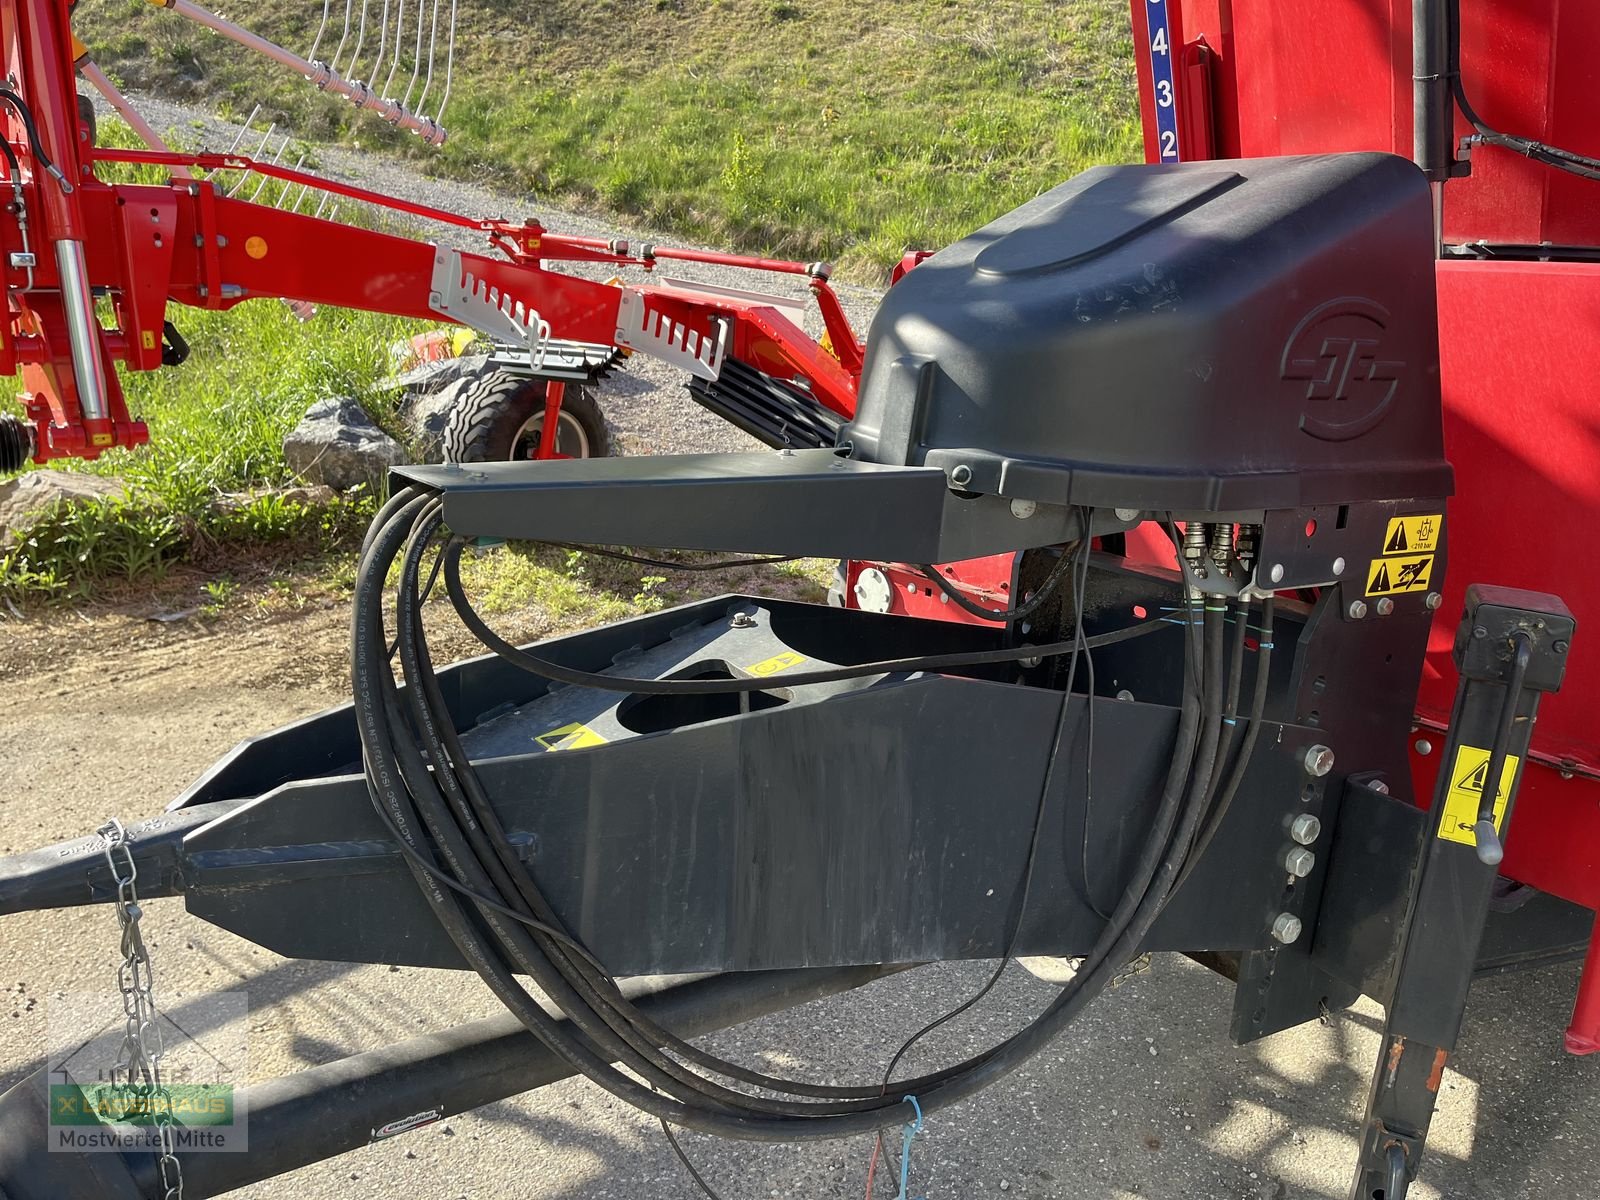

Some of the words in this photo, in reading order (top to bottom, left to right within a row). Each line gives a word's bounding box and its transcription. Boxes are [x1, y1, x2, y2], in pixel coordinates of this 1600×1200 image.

[1152, 27, 1168, 56] 4
[1157, 80, 1172, 108] 3
[1161, 130, 1176, 157] 2
[359, 668, 368, 688] SAE
[368, 727, 378, 743] EN
[379, 769, 391, 788] ISO
